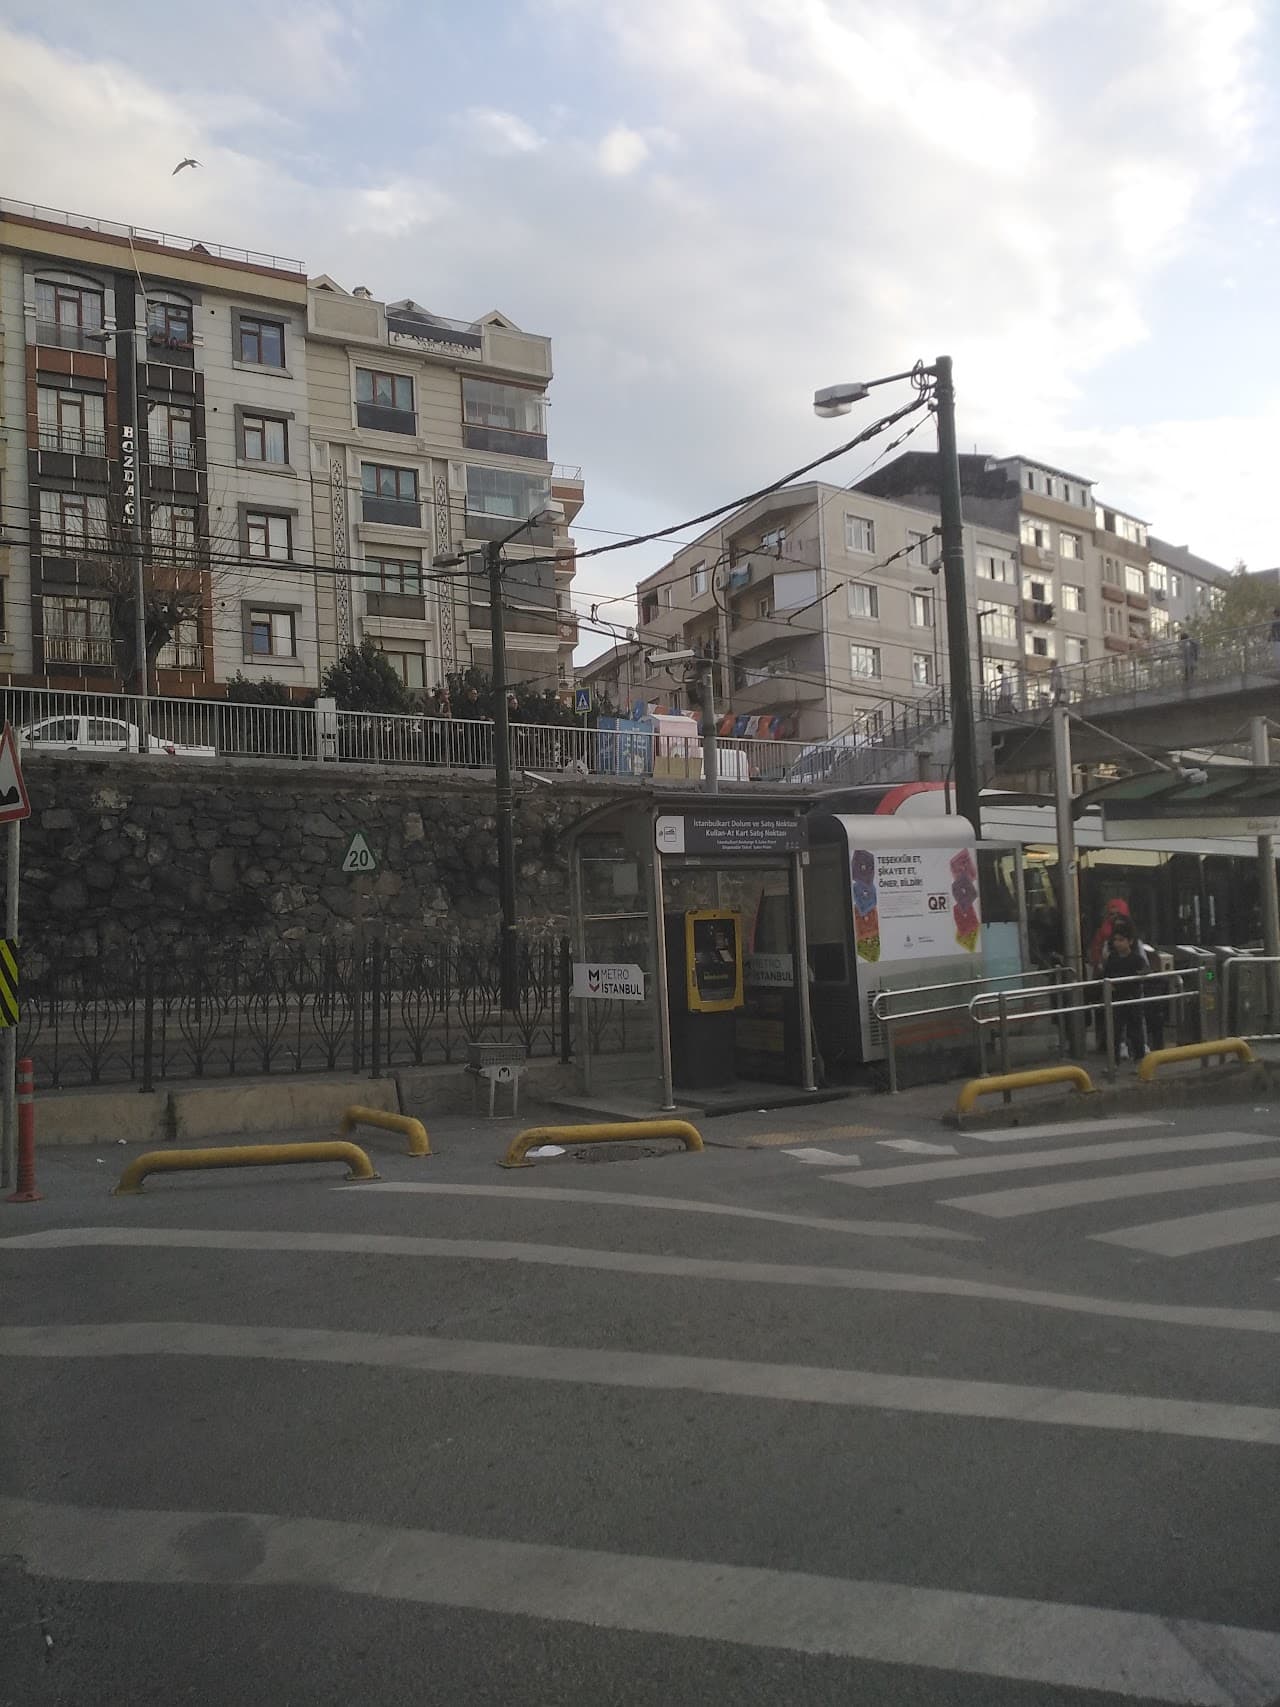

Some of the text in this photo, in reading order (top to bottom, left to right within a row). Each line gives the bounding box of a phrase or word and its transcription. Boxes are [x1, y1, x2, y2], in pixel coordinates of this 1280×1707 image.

[122, 426, 135, 515] BOZDAĞ
[693, 818, 730, 827] İstanbulkart
[731, 819, 751, 827] Dolum
[760, 819, 775, 828] Satış
[776, 819, 797, 827] Noktası
[705, 829, 787, 839] Kullan-At Kart Satış Noktası
[349, 850, 369, 868] 20
[877, 854, 921, 865] TEŞEKKÜR ET,
[878, 866, 917, 877] ŞİKAYET ET,
[879, 879, 899, 888] ÖNER,
[928, 896, 947, 911] QR
[601, 969, 629, 980] METRO
[601, 981, 642, 995] İSTANBUL
